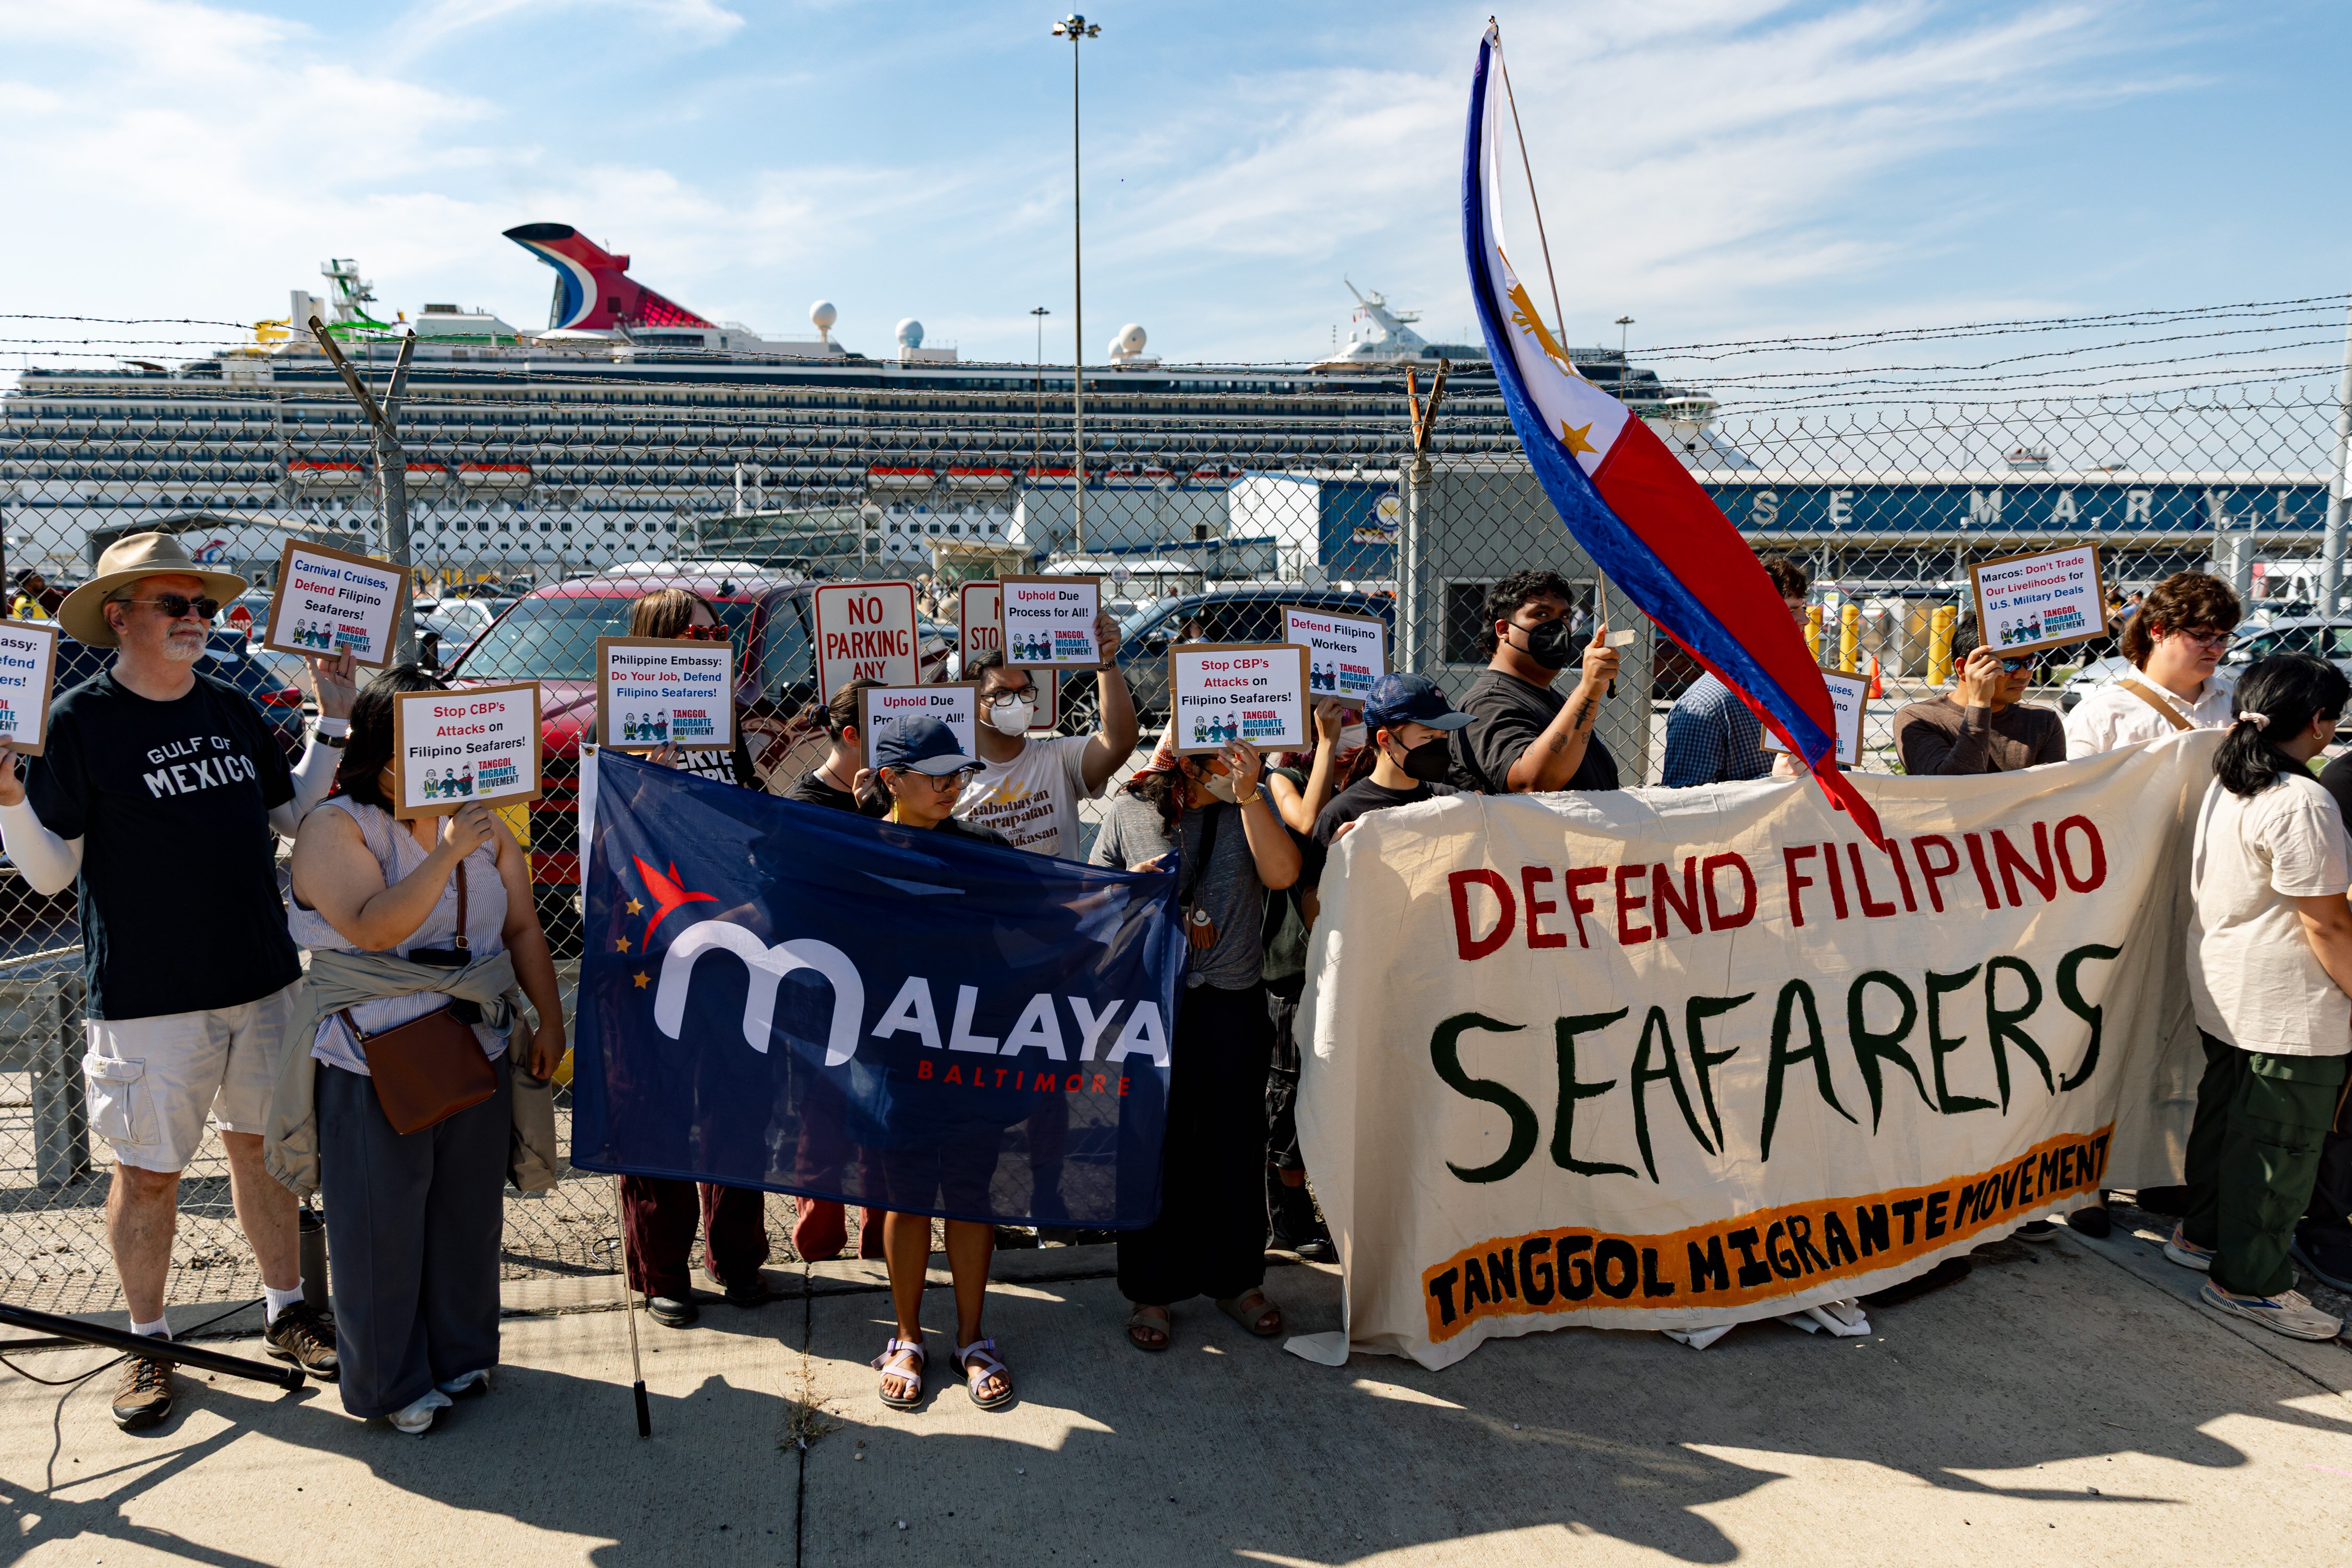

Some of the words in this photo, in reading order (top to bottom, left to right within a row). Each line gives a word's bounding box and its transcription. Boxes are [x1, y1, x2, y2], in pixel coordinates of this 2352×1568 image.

[295, 560, 340, 579] Carnival
[344, 571, 388, 591] Cruises,
[1981, 569, 2023, 583] Marcos:
[2026, 562, 2053, 574] Don't
[2056, 557, 2084, 569] Trade
[1986, 586, 2004, 596] Our
[2008, 575, 2066, 592] Livelihoods
[2069, 571, 2084, 581] for
[295, 578, 335, 596] Defend
[339, 588, 381, 606] Filipino
[1018, 591, 1055, 602] Uphold
[1059, 591, 1079, 601] Due
[1990, 601, 2010, 610] U.S.
[2013, 592, 2051, 606] Military
[2055, 585, 2084, 597] Deals
[305, 599, 364, 620] Seafarers!
[848, 597, 883, 625] NO
[1009, 607, 1051, 617] Process
[1054, 608, 1069, 617] for
[1072, 608, 1088, 617] All!
[2043, 605, 2076, 618] TANGGOL
[2044, 612, 2082, 626] MIGRANTE
[2045, 619, 2085, 633] MOVEMENT
[338, 624, 367, 636] TANGGOL
[1292, 618, 1330, 632] Defend
[1334, 625, 1375, 639] Filipino
[336, 631, 370, 644] MIGRANTE
[827, 629, 908, 660] PARKING
[1, 638, 37, 652] assy:
[335, 640, 371, 653] MOEMENT
[1056, 647, 1092, 655] MOVEMENT
[1311, 638, 1357, 653] Workers
[612, 655, 667, 666] Philippine
[671, 656, 722, 667] Embassy:
[1202, 660, 1229, 671] Stop
[1233, 659, 1269, 669] CBP's
[853, 661, 886, 680] ANY
[1340, 663, 1370, 675] TANGGOL
[612, 672, 627, 681] Do
[631, 672, 655, 681] Your
[659, 672, 680, 683] Job,
[684, 672, 721, 682] Defend
[1204, 677, 1249, 687] Attacks
[1340, 672, 1375, 683] MIGRANTE
[1340, 680, 1371, 691] MOVEME
[617, 688, 658, 698] Filipino
[662, 688, 717, 697] Seafarers!
[1182, 695, 1226, 707] Filipino
[1230, 693, 1292, 704] Seafarers!
[883, 696, 926, 709] Uphold
[931, 696, 954, 705] Due
[434, 707, 466, 718] Stop
[470, 702, 505, 715] CBP's
[673, 709, 707, 718] TANGGOL
[1242, 710, 1277, 719] TANGGOL
[673, 718, 711, 727] MIGRANTE
[946, 713, 964, 723] All!
[1243, 719, 1282, 728] MIGRANTE
[436, 724, 485, 737] Attacks
[489, 723, 503, 732] on
[673, 727, 714, 735] MOVEMENT
[1243, 728, 1285, 736] MOVEMENT
[147, 737, 203, 764] GULF
[211, 736, 230, 750] OF
[410, 746, 462, 758] Filipino
[466, 736, 525, 754] Seafarers!
[478, 757, 511, 770] TANGGOL
[143, 755, 255, 798] MEXICO
[479, 766, 516, 779] MIGRANTE
[479, 775, 519, 789] MOVEMENT
[1010, 827, 1058, 847] ukasan
[1447, 851, 1757, 962] DEFEND
[1783, 814, 2107, 928] FILIPINO
[1430, 943, 2125, 1185] SEAFARERS
[918, 1060, 1130, 1096] BALTIMORE
[1430, 1236, 1675, 1328] TANGGOL
[1689, 1190, 1950, 1294] MIGRANTE
[1954, 1127, 2112, 1230] MOVEMENT
